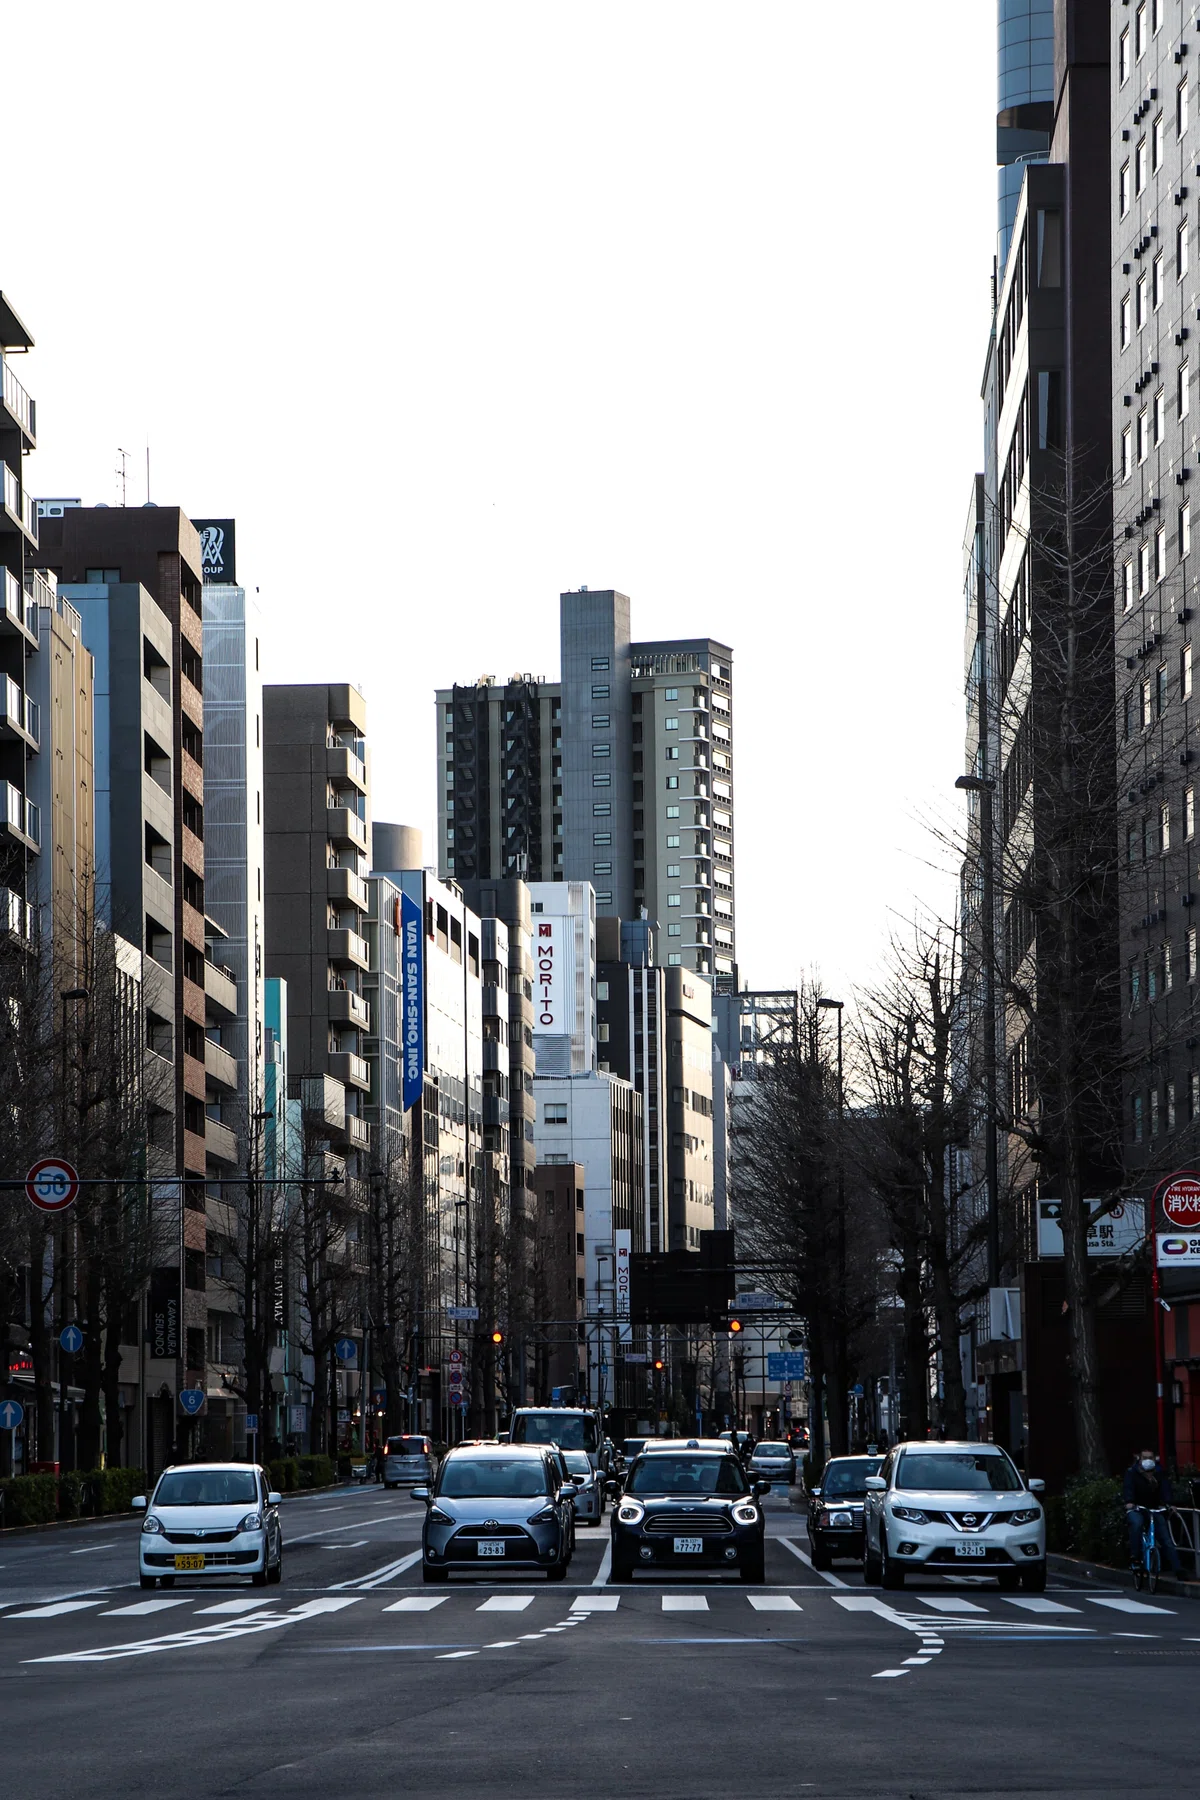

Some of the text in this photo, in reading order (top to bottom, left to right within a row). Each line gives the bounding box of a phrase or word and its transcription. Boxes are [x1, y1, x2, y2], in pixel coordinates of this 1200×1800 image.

[407, 920, 417, 958] VAN
[538, 945, 553, 1025] MORITO
[1085, 1225, 1114, 1239] 草駅
[167, 1299, 177, 1355] KAWAMURA
[155, 1312, 165, 1356] SEIUNDO
[188, 1395, 196, 1405] 6
[483, 1547, 504, 1555] 29-83
[680, 1543, 702, 1552] 77-77
[962, 1547, 985, 1555] 92-15
[181, 1560, 203, 1569] 59-07
